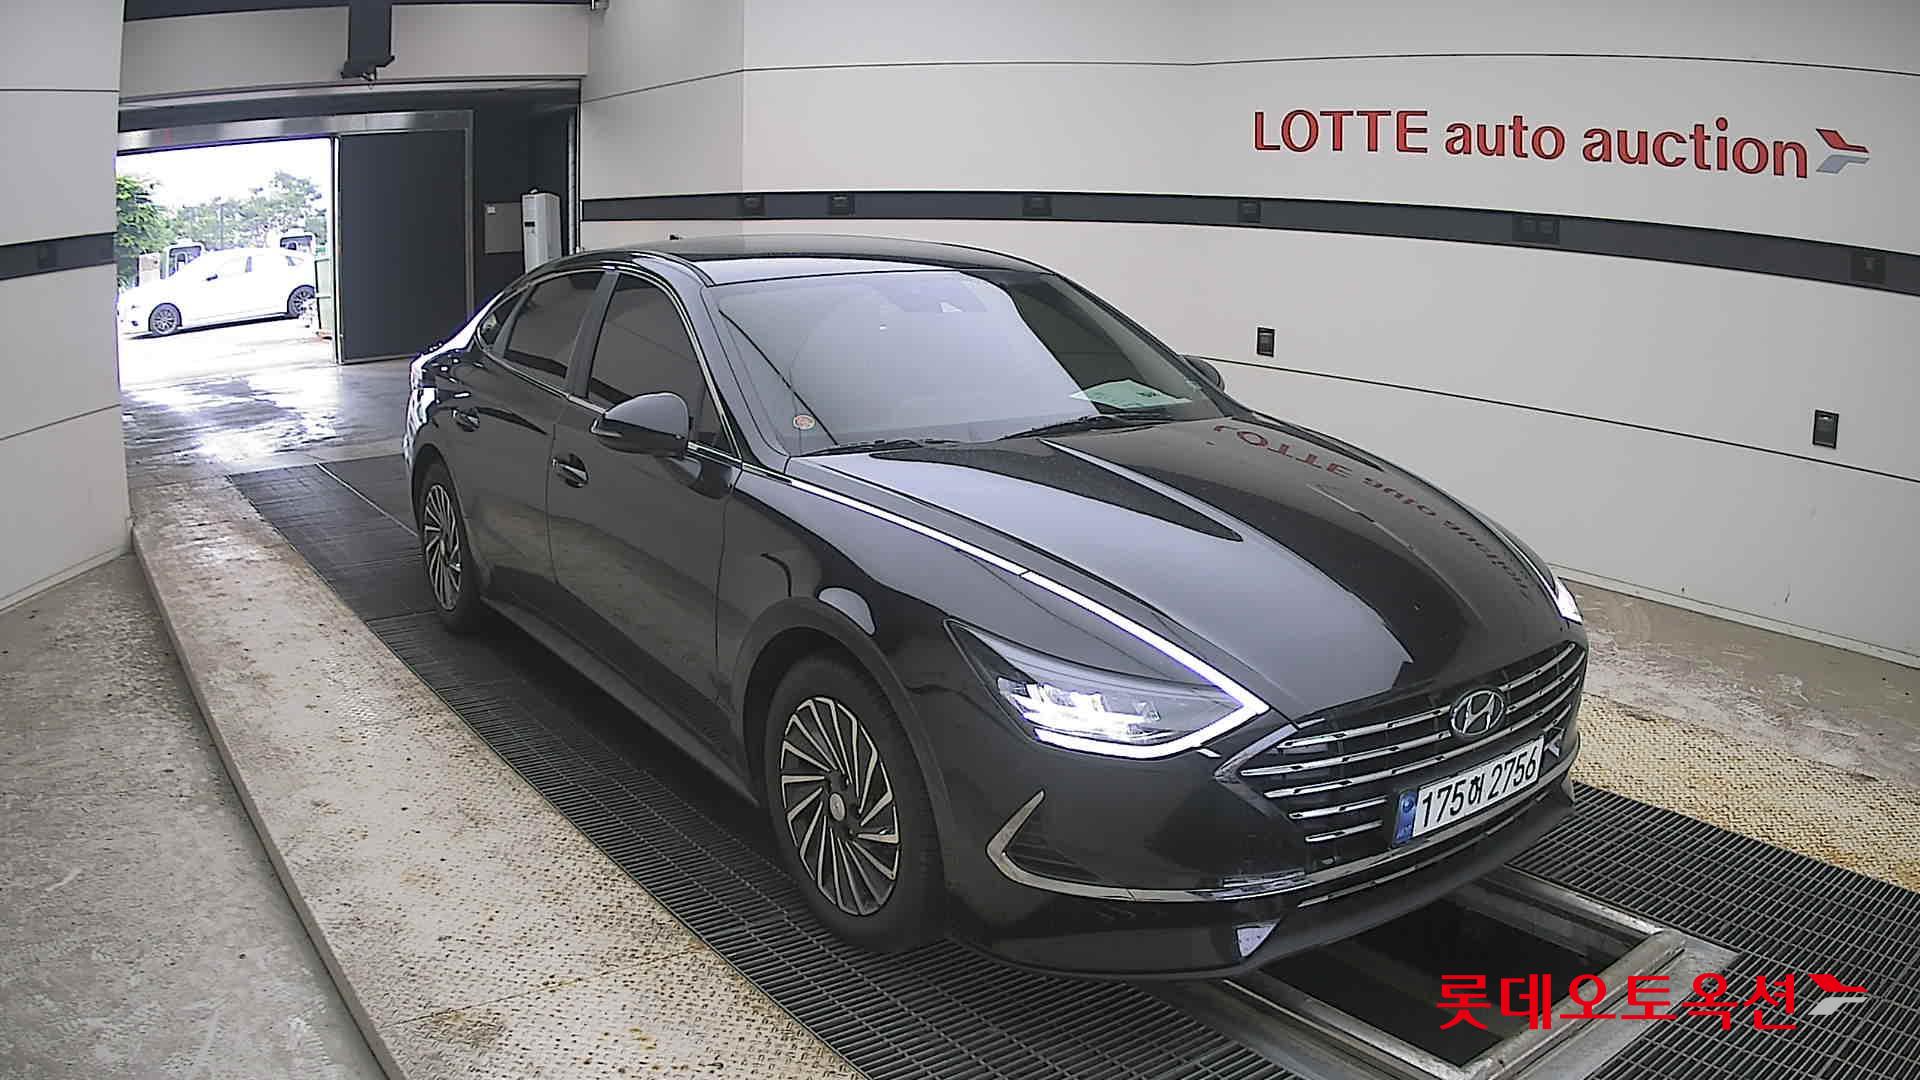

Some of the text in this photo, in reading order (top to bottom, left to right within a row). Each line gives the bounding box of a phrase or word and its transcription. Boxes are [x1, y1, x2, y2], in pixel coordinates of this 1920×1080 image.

[1255, 110, 1808, 179] LOTTE auto auction
[1422, 745, 1538, 828] 175허 2756
